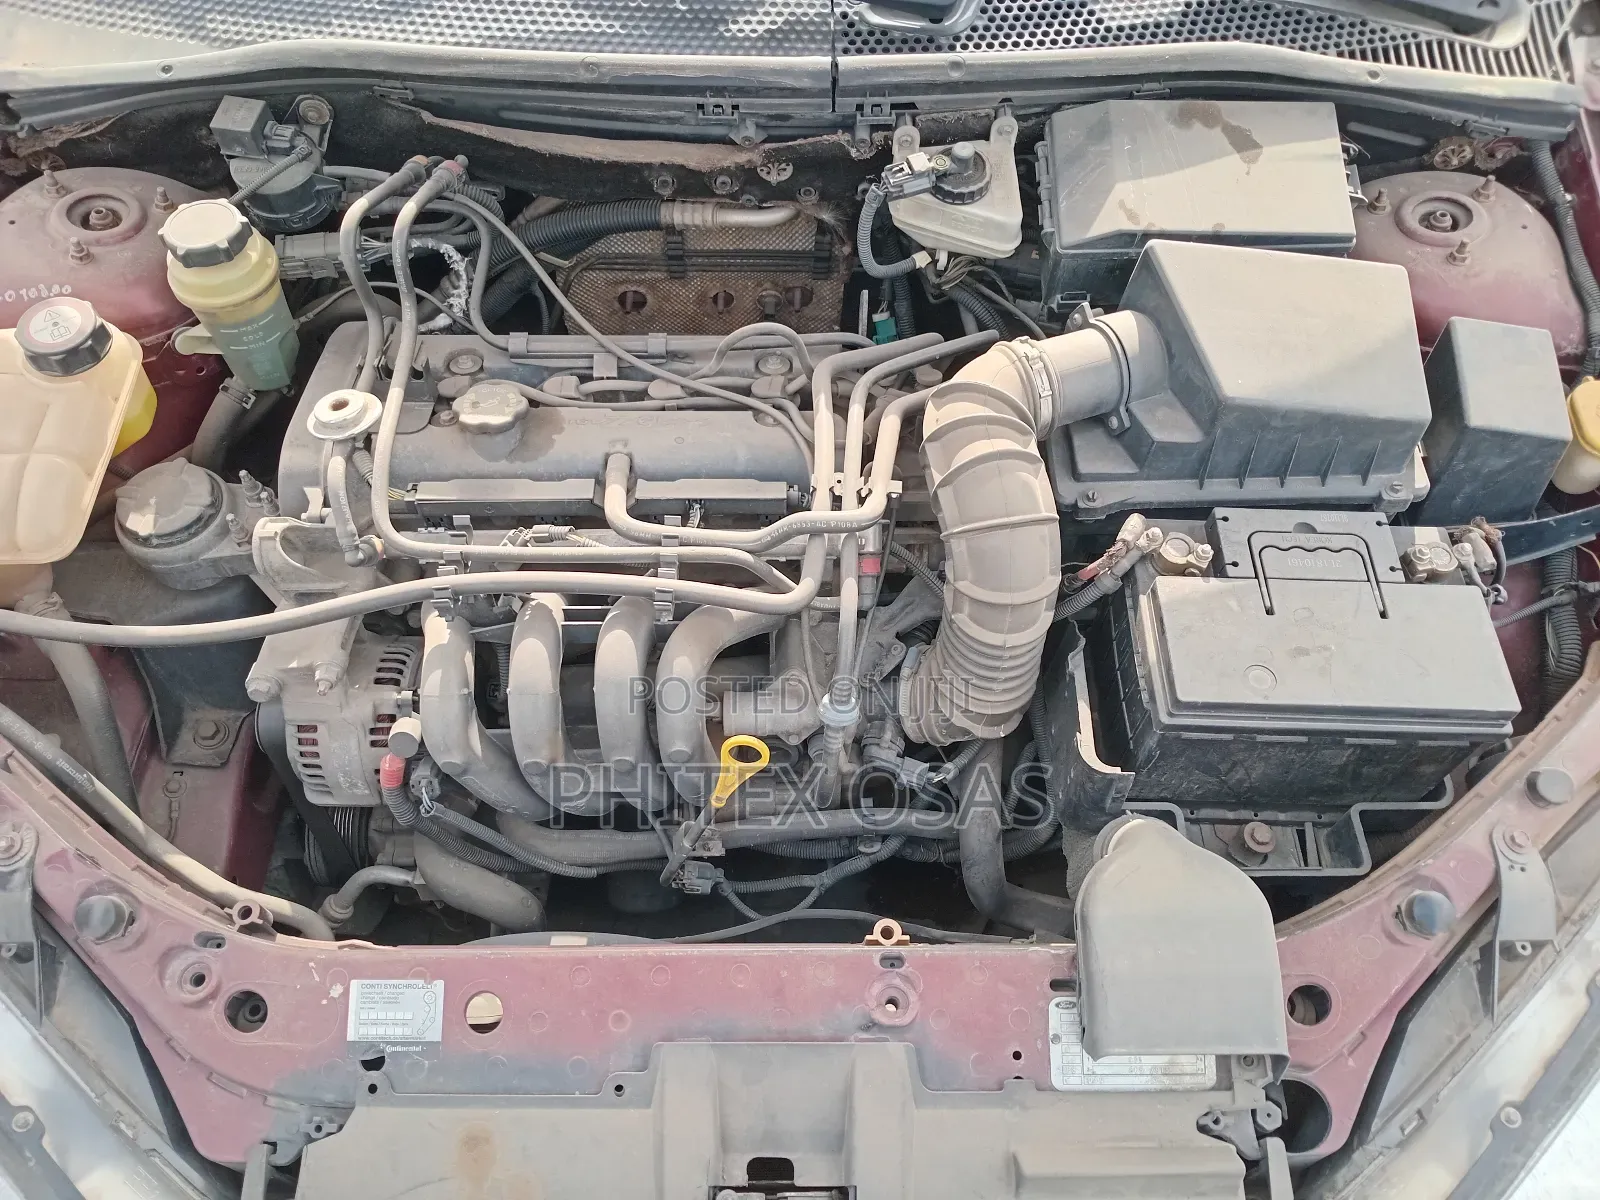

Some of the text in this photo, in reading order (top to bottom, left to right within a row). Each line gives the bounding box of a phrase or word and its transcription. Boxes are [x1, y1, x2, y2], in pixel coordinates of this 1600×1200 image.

[240, 323, 259, 333] MAX
[242, 331, 264, 342] COLD
[248, 341, 266, 350] MIN
[55, 758, 95, 793] Motorcraft
[386, 1044, 422, 1053] Continental
